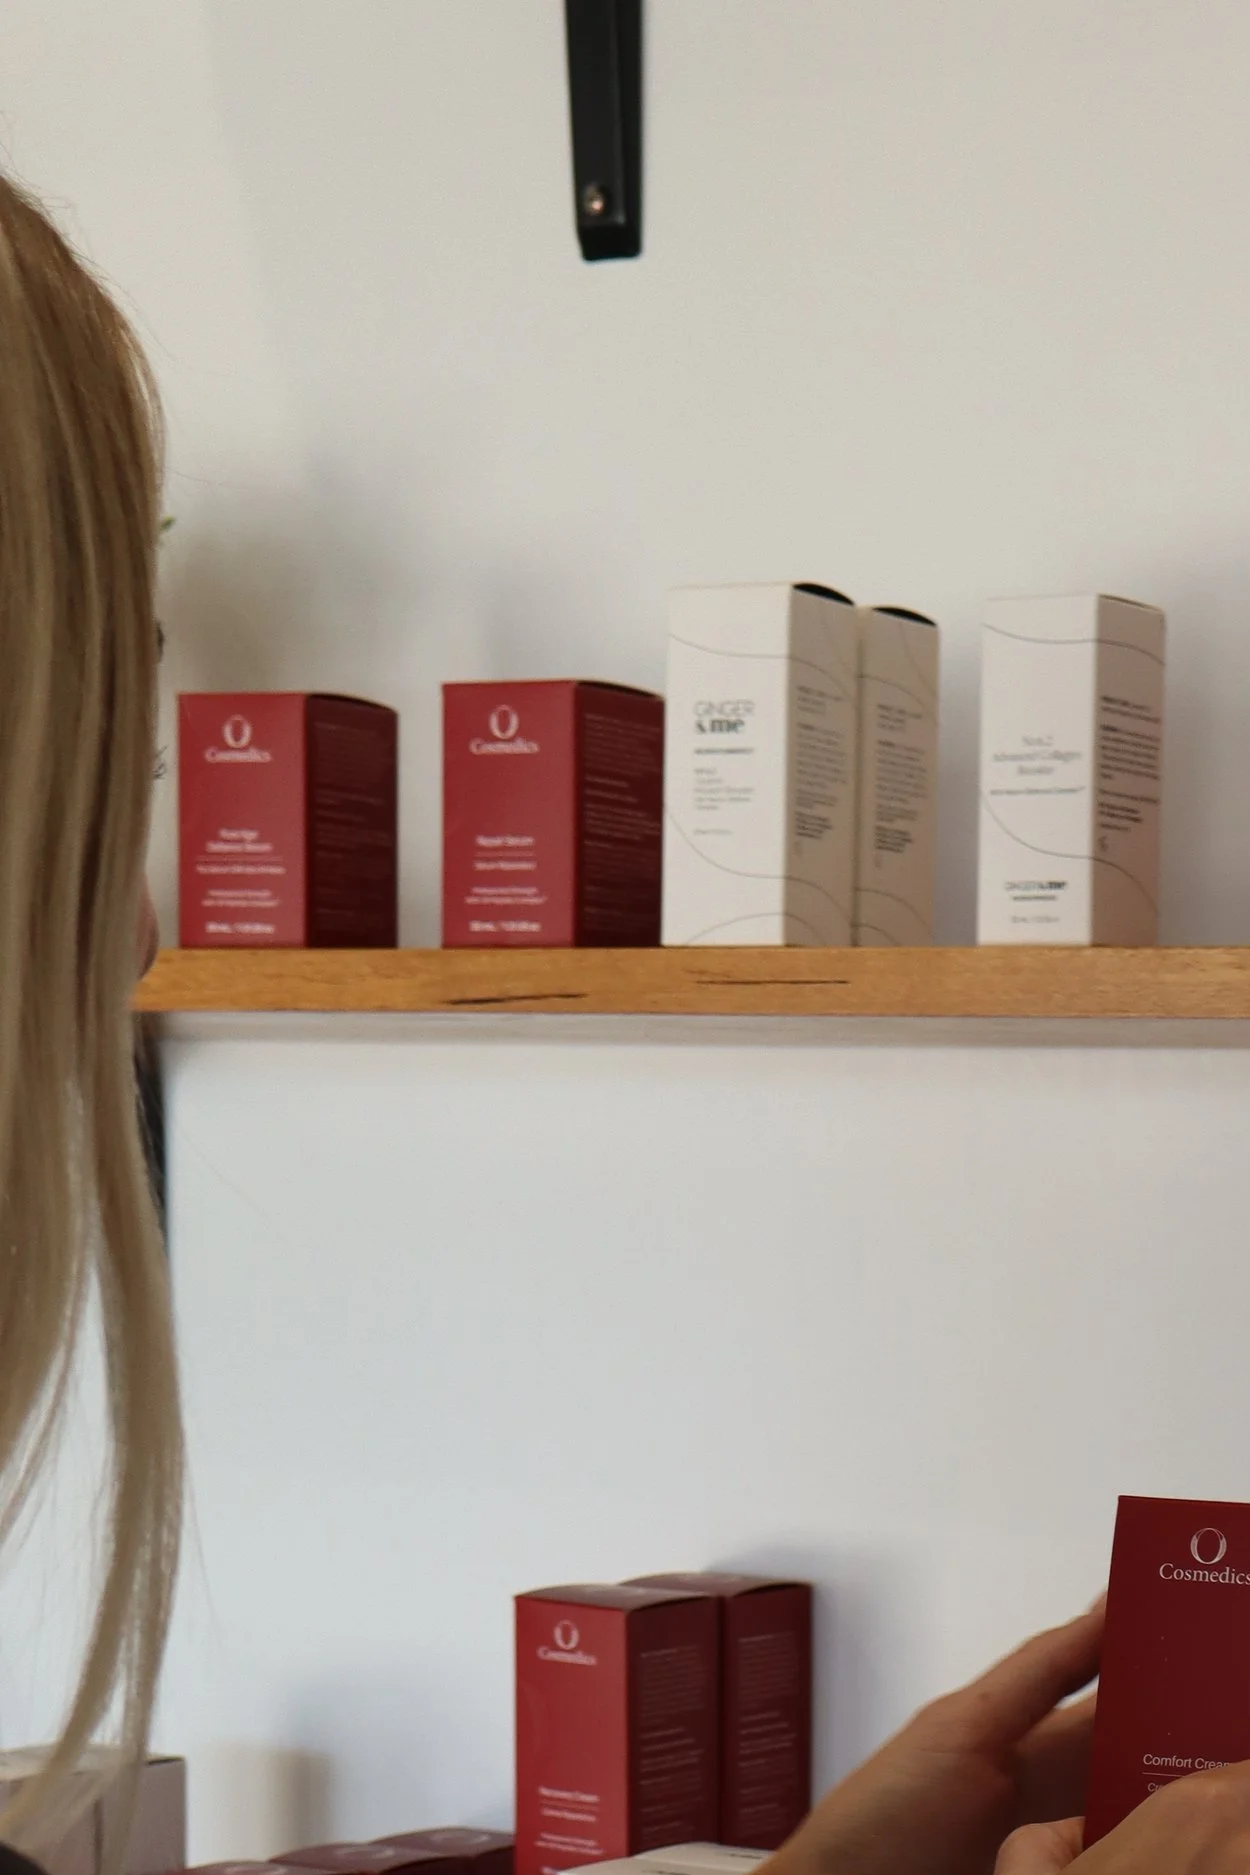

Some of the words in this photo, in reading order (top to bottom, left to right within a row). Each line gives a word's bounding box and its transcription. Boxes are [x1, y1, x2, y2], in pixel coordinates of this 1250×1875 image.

[1190, 1527, 1227, 1564] O
[1143, 1754, 1191, 1769] Comfort
[1194, 1758, 1229, 1770] Crea
